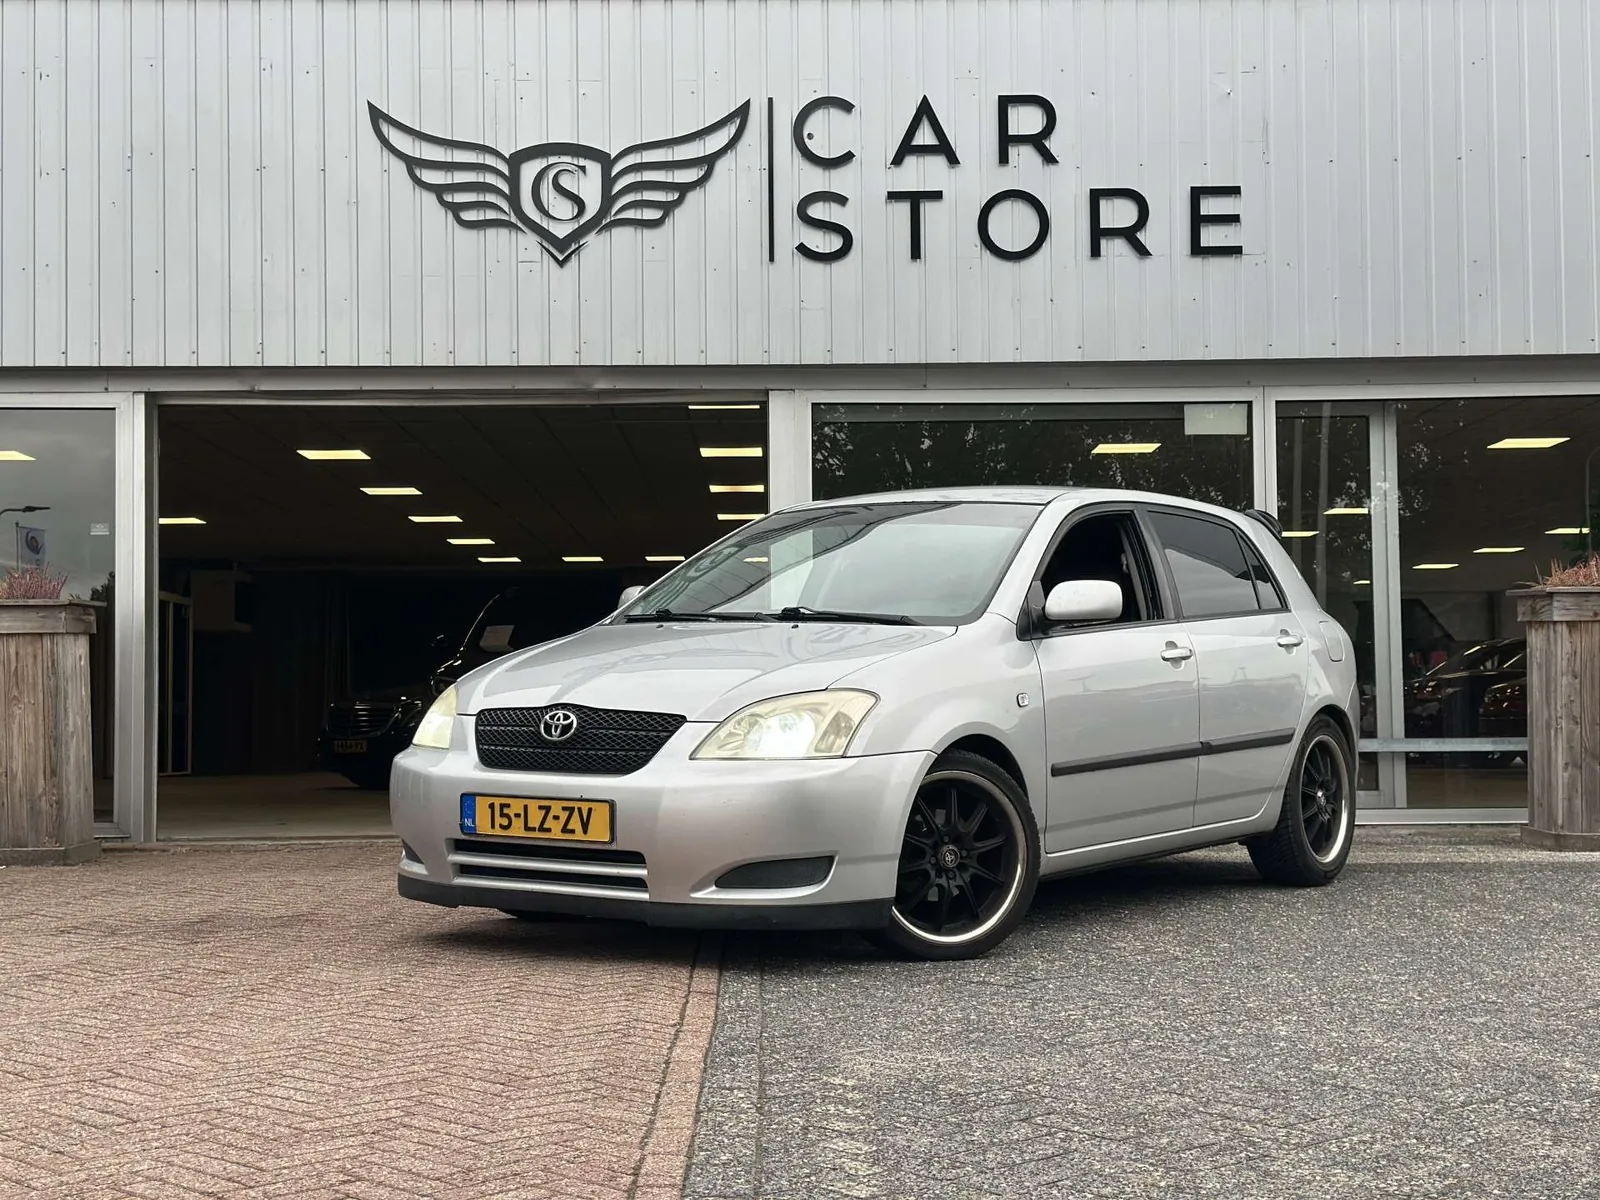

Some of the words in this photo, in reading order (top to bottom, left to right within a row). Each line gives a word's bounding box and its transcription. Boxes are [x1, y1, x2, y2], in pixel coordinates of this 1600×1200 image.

[793, 95, 1060, 171] CAR
[795, 186, 1244, 264] STORE
[464, 818, 475, 828] NL
[487, 801, 593, 835] 15-LZ-ZV
